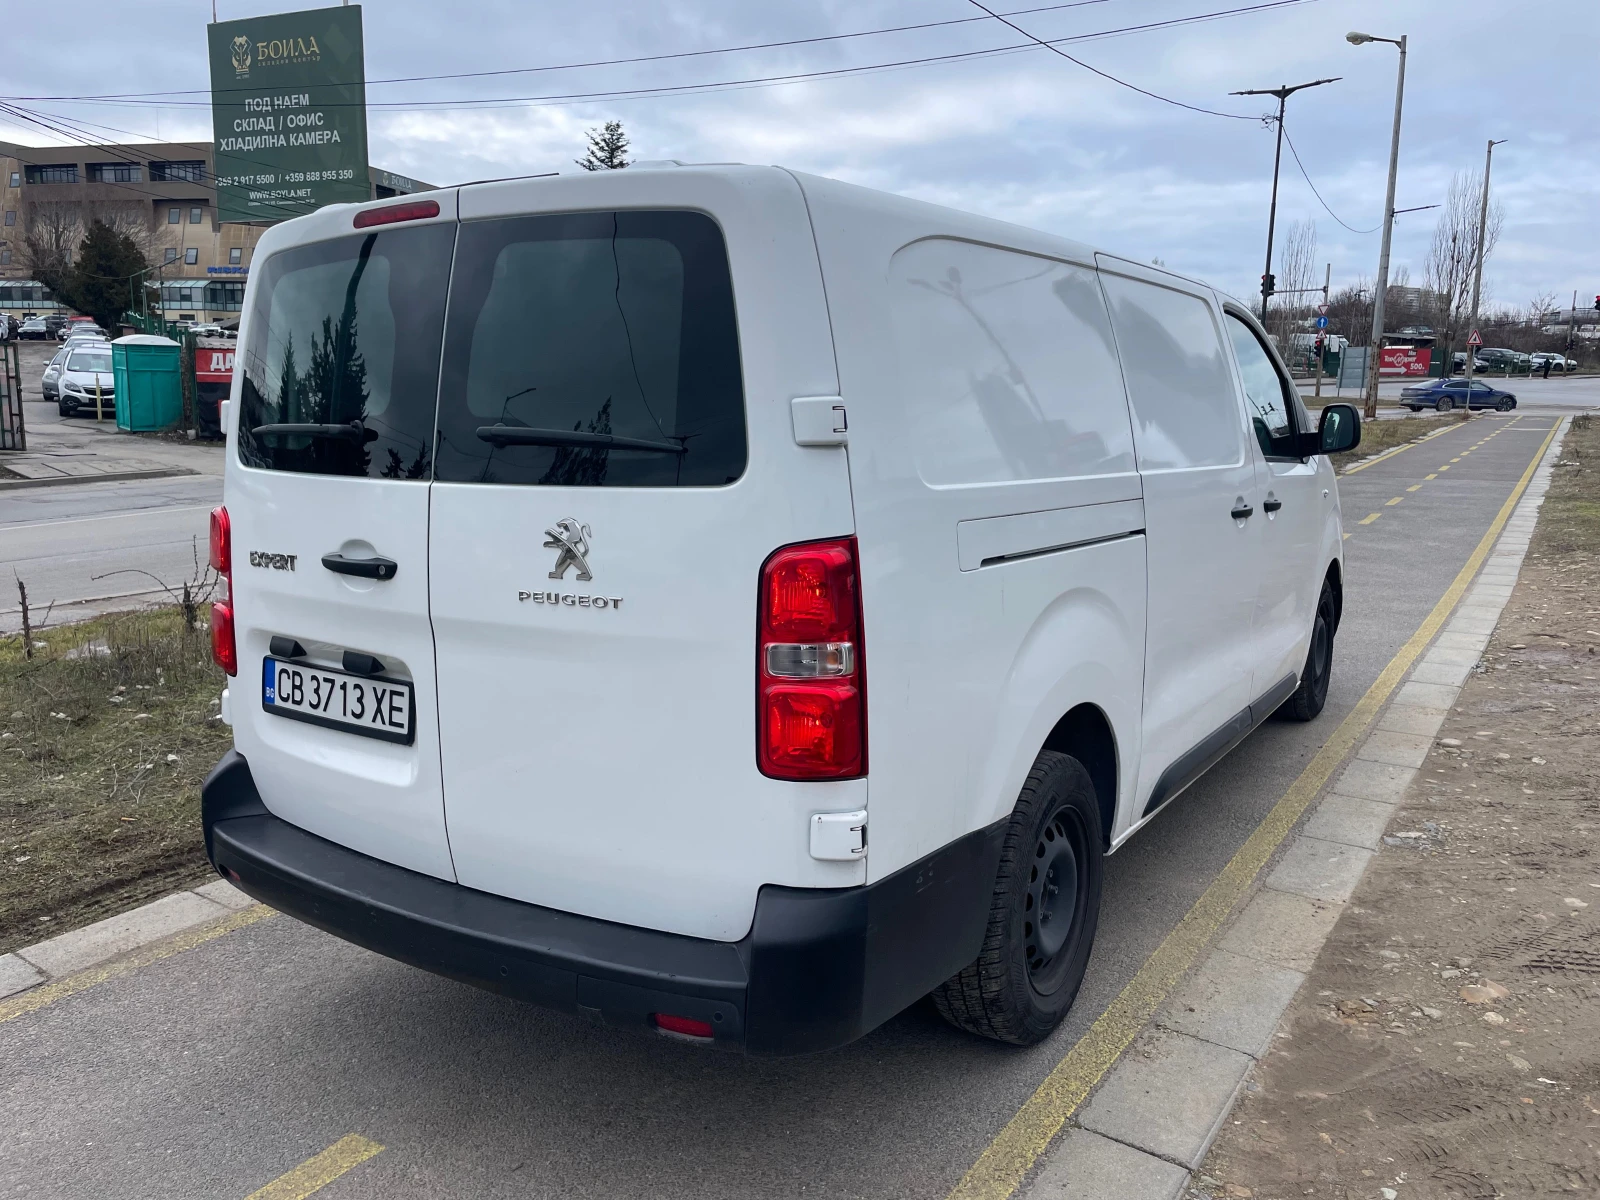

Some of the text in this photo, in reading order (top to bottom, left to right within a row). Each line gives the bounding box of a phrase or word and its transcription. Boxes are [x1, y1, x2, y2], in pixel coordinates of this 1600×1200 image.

[256, 36, 320, 60] БОИЛА
[245, 93, 310, 113] ПОД НАЕМ
[233, 112, 324, 132] СКЛАД / ОФИС
[220, 130, 341, 152] ХЛАДИЛНА КАМЕРА
[233, 176, 239, 186] 2
[240, 175, 254, 186] 917
[256, 174, 275, 184] 5500
[285, 171, 304, 182] +359
[322, 170, 337, 180] 955
[338, 169, 353, 179] 350
[249, 551, 297, 572] EXPERT
[518, 589, 623, 609] PEUGEOT
[265, 686, 275, 698] BG
